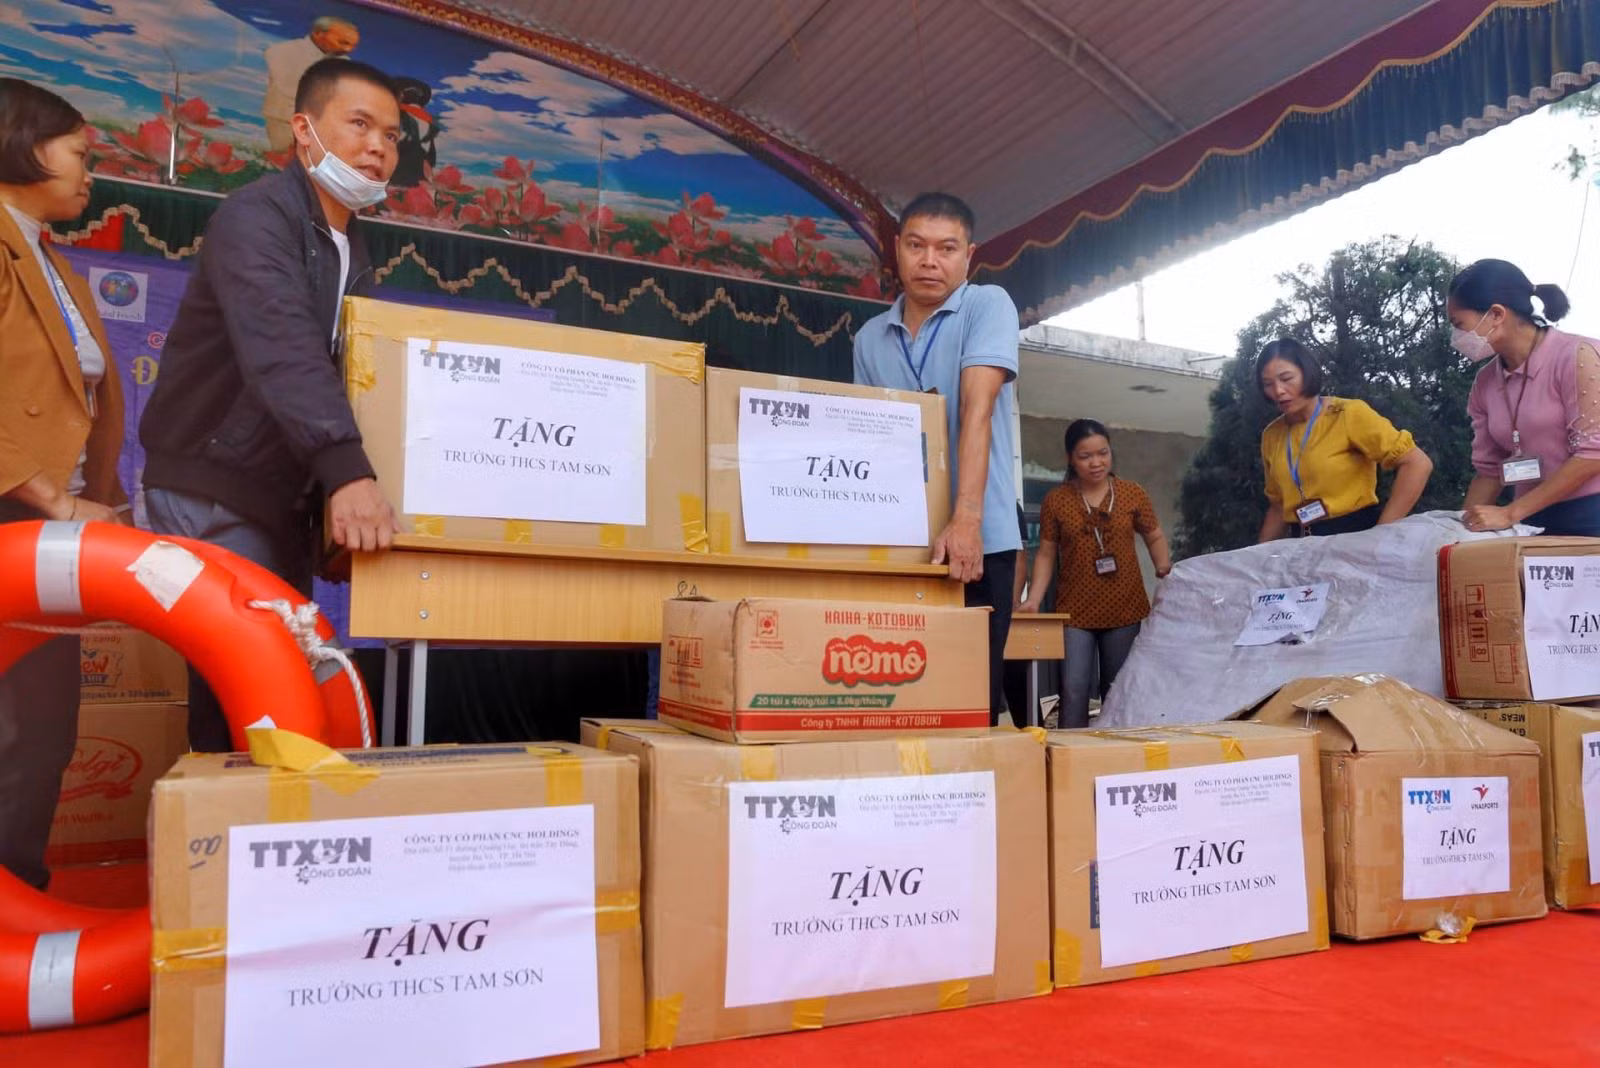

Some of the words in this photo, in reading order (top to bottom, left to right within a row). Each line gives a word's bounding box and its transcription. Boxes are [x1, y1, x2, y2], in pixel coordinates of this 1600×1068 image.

[420, 349, 501, 375] TTXVN
[749, 397, 810, 419] TTXVN
[492, 417, 576, 448] TẶNG
[443, 449, 506, 467] TRƯỜNG
[510, 455, 545, 471] THCS
[550, 459, 580, 474] TAM
[584, 461, 611, 476] SƠN
[806, 454, 870, 482] TẶNG
[769, 484, 819, 499] TRƯỜNG
[823, 488, 849, 501] THCS
[853, 491, 876, 503] TAM
[878, 492, 900, 504] SƠN
[1529, 565, 1574, 581] TTXVN
[1569, 611, 1600, 638] TẶN
[801, 717, 823, 728] Công
[825, 718, 833, 729] ty
[836, 717, 859, 726] TNHH
[744, 796, 836, 818] TTXVN
[1106, 782, 1177, 806] TTXVN
[1408, 789, 1451, 805] TTXVN
[1440, 826, 1476, 850] TẶNG
[249, 837, 371, 868] TTXVN
[1173, 839, 1245, 876] TẶNG
[300, 866, 335, 881] CÔNG
[337, 865, 371, 878] ĐOÀN
[829, 864, 924, 906] TẶNG
[1132, 886, 1188, 905] TRƯỜNG
[1190, 882, 1221, 898] THCS
[1224, 879, 1251, 893] TAM
[1253, 874, 1277, 888] SƠN
[772, 915, 844, 936] TRƯỜNG
[848, 914, 890, 931] THCS
[894, 911, 927, 928] TAM
[930, 908, 960, 924] SƠN
[362, 918, 489, 966] TẶNG
[289, 977, 382, 1007] TRƯỜNG
[390, 975, 444, 998] THCS
[452, 972, 497, 993] TAM
[502, 969, 545, 987] SƠN
